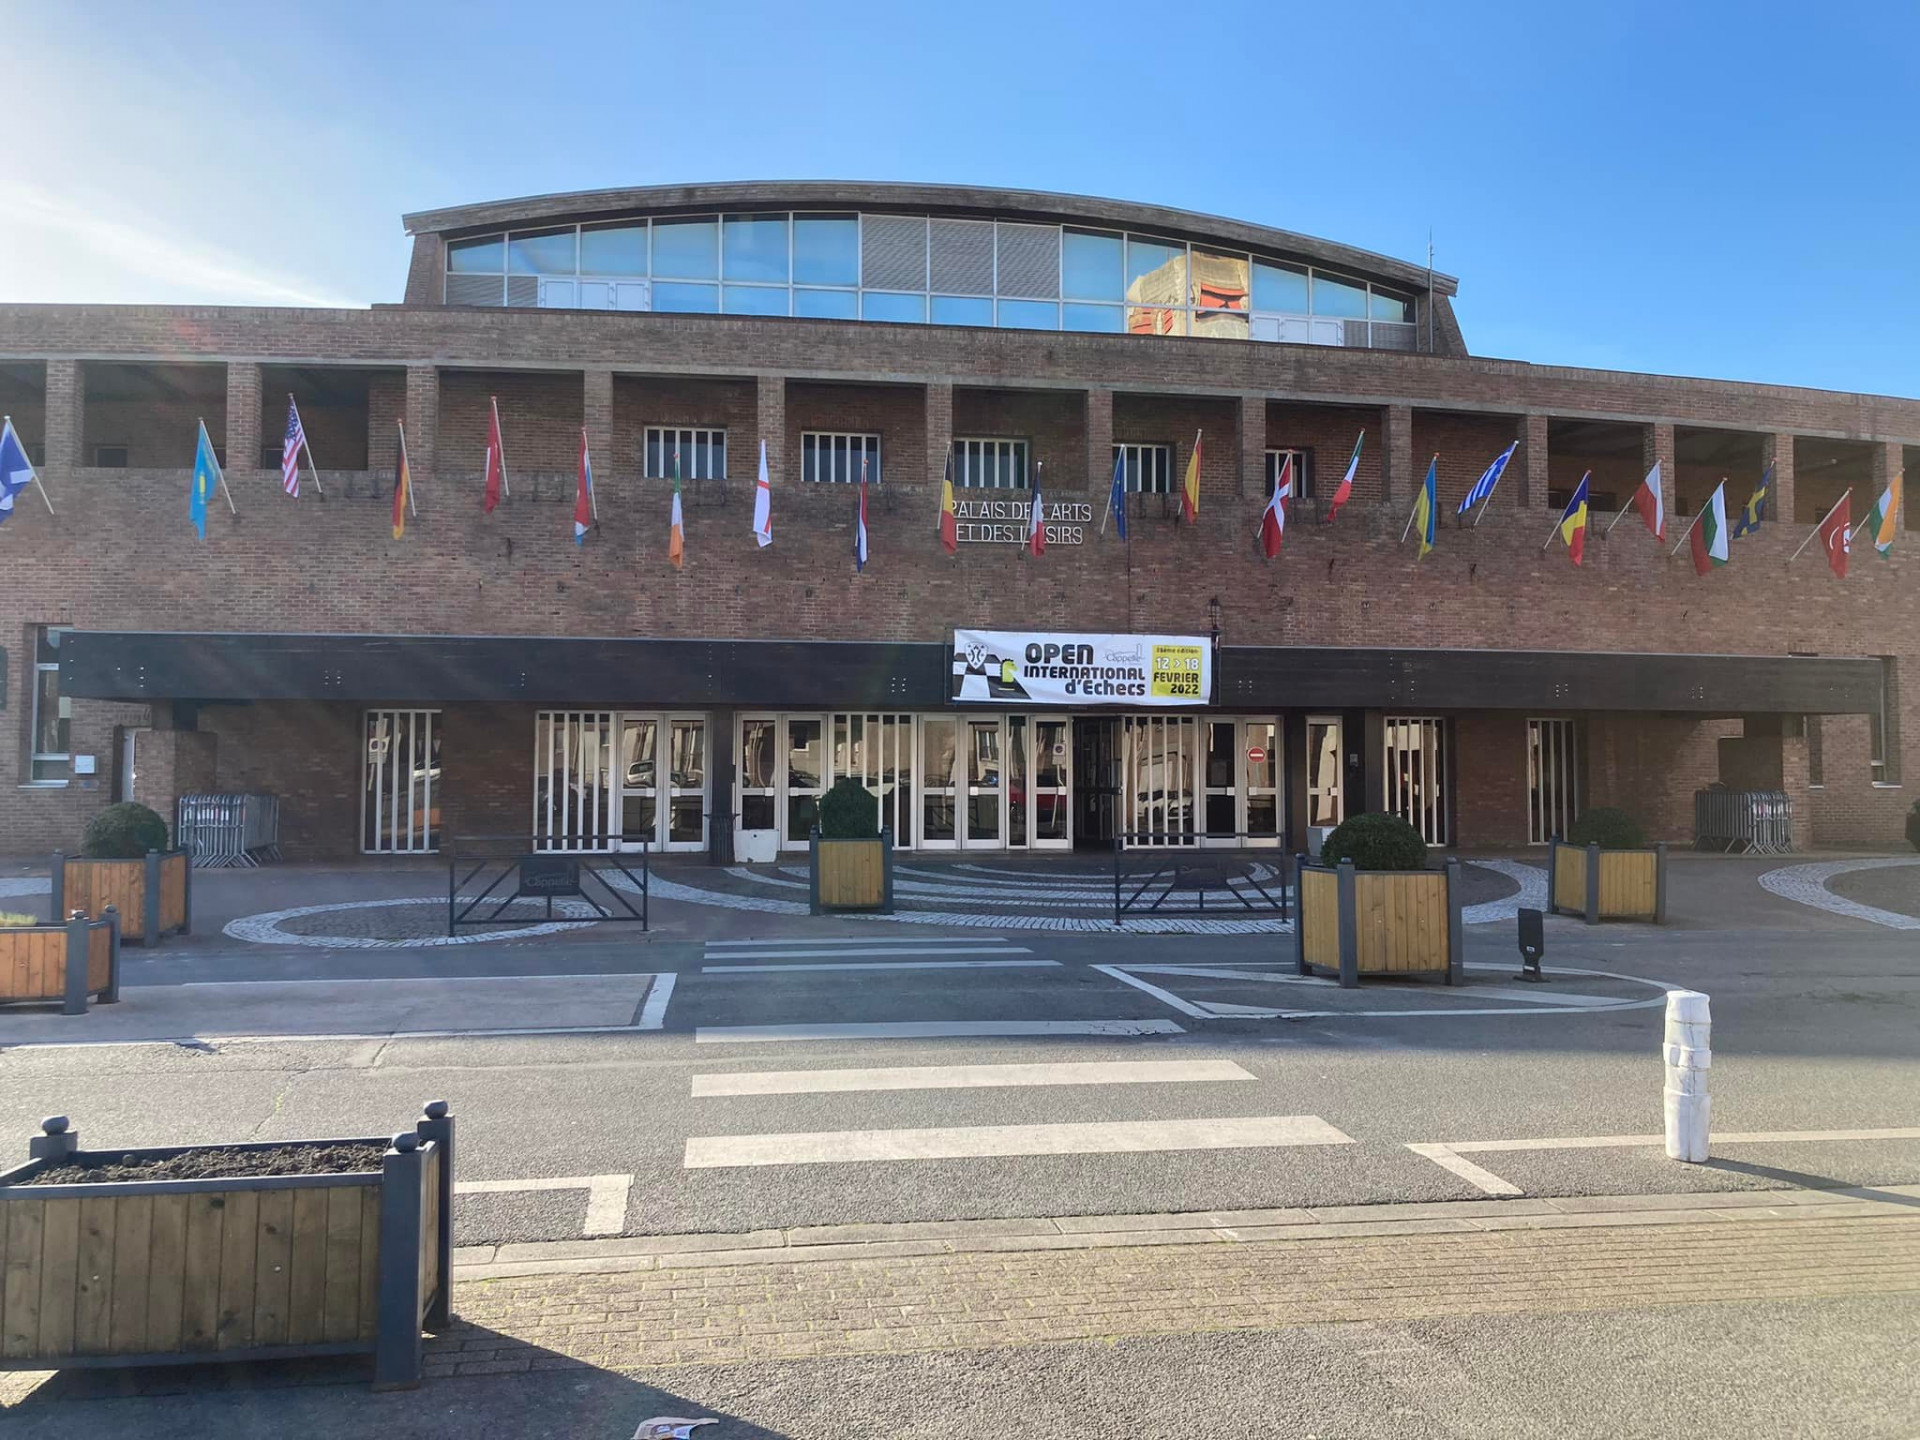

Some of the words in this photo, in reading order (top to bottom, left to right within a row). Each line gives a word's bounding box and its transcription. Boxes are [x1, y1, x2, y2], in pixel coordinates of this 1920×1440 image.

[951, 500, 1006, 519] PALAIS
[1012, 501, 1031, 519] DE
[1050, 503, 1092, 522] ARTS
[955, 523, 976, 542] ET
[981, 524, 1014, 543] DES
[1020, 525, 1083, 545] LSIRS
[1025, 643, 1094, 665] OPEN
[1156, 657, 1170, 670] 12
[1185, 658, 1200, 671] 18
[1024, 665, 1146, 681] INTERNATIONAL
[1153, 672, 1200, 683] FEVRIER
[1065, 680, 1146, 696] d'Echecs
[1170, 684, 1200, 695] 2022
